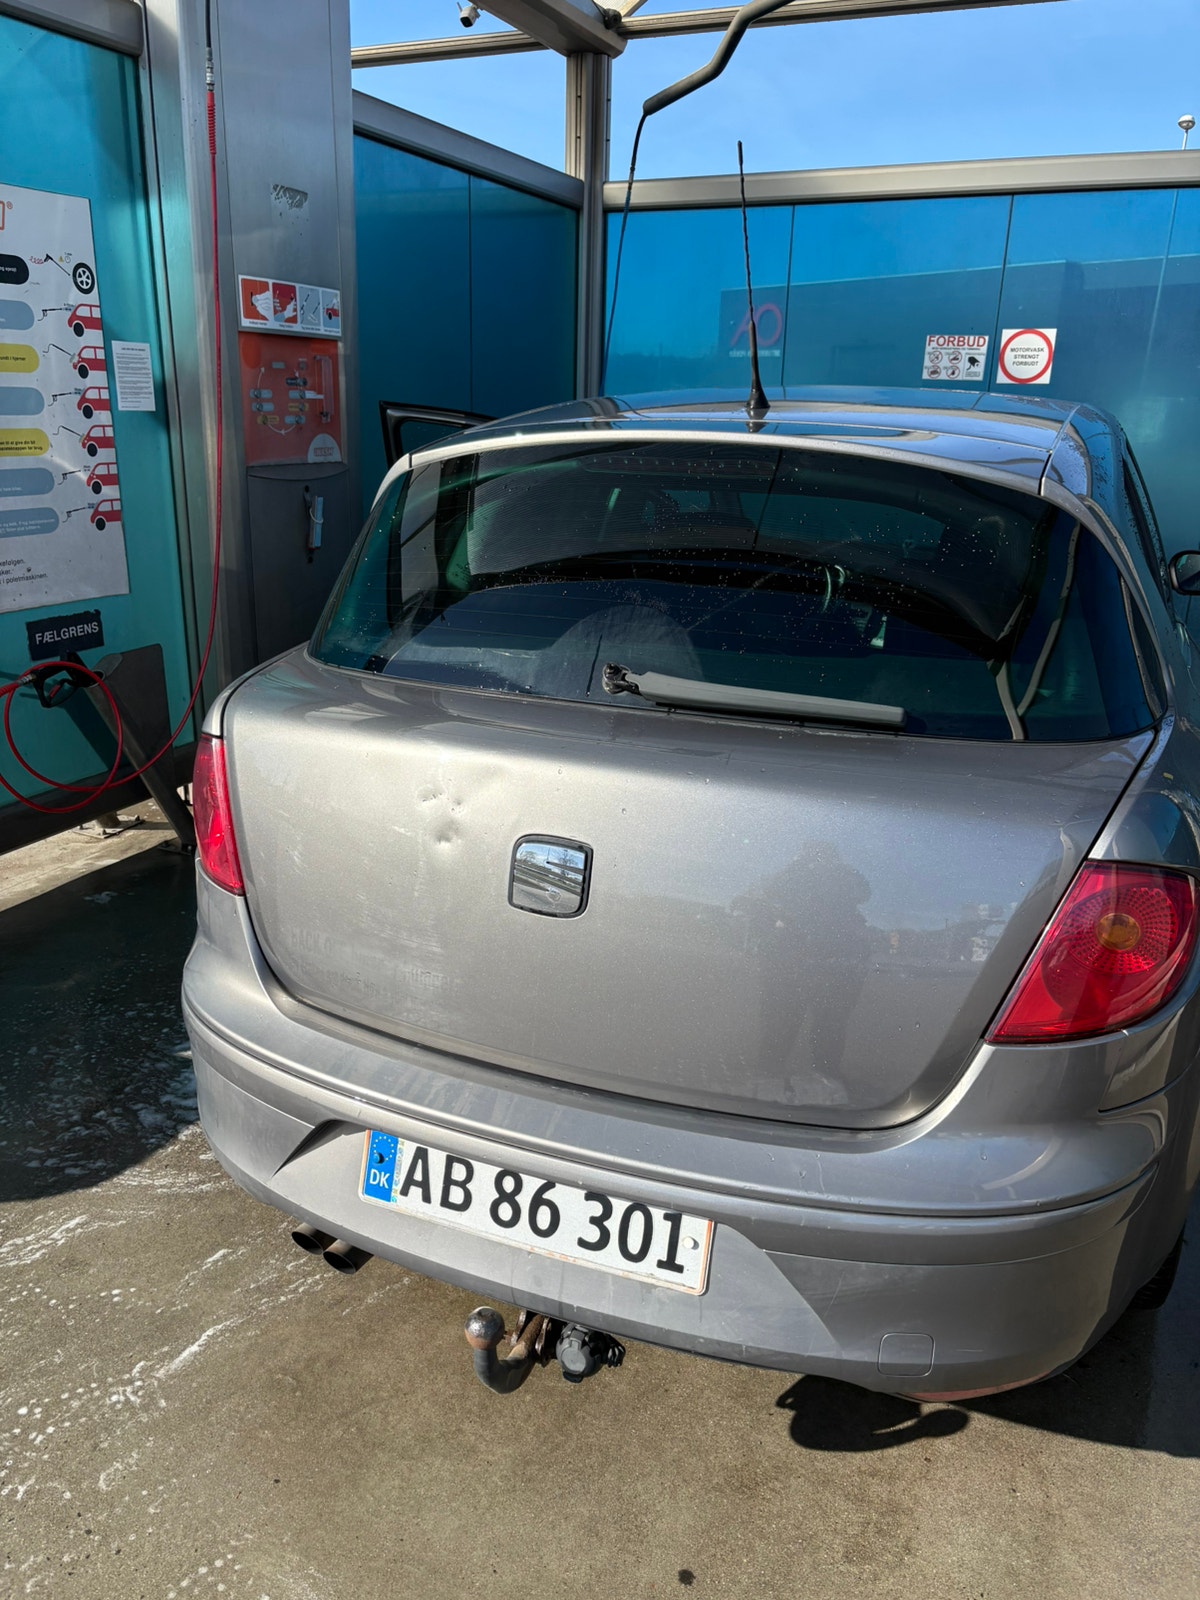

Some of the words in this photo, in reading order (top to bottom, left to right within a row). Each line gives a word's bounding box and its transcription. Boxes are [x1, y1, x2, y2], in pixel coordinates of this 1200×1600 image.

[927, 335, 987, 348] FORBUD
[35, 622, 100, 646] FÆLGRENS
[369, 1168, 391, 1190] DK
[399, 1146, 475, 1213] AB
[489, 1168, 561, 1239] 86
[577, 1191, 685, 1274] 301
